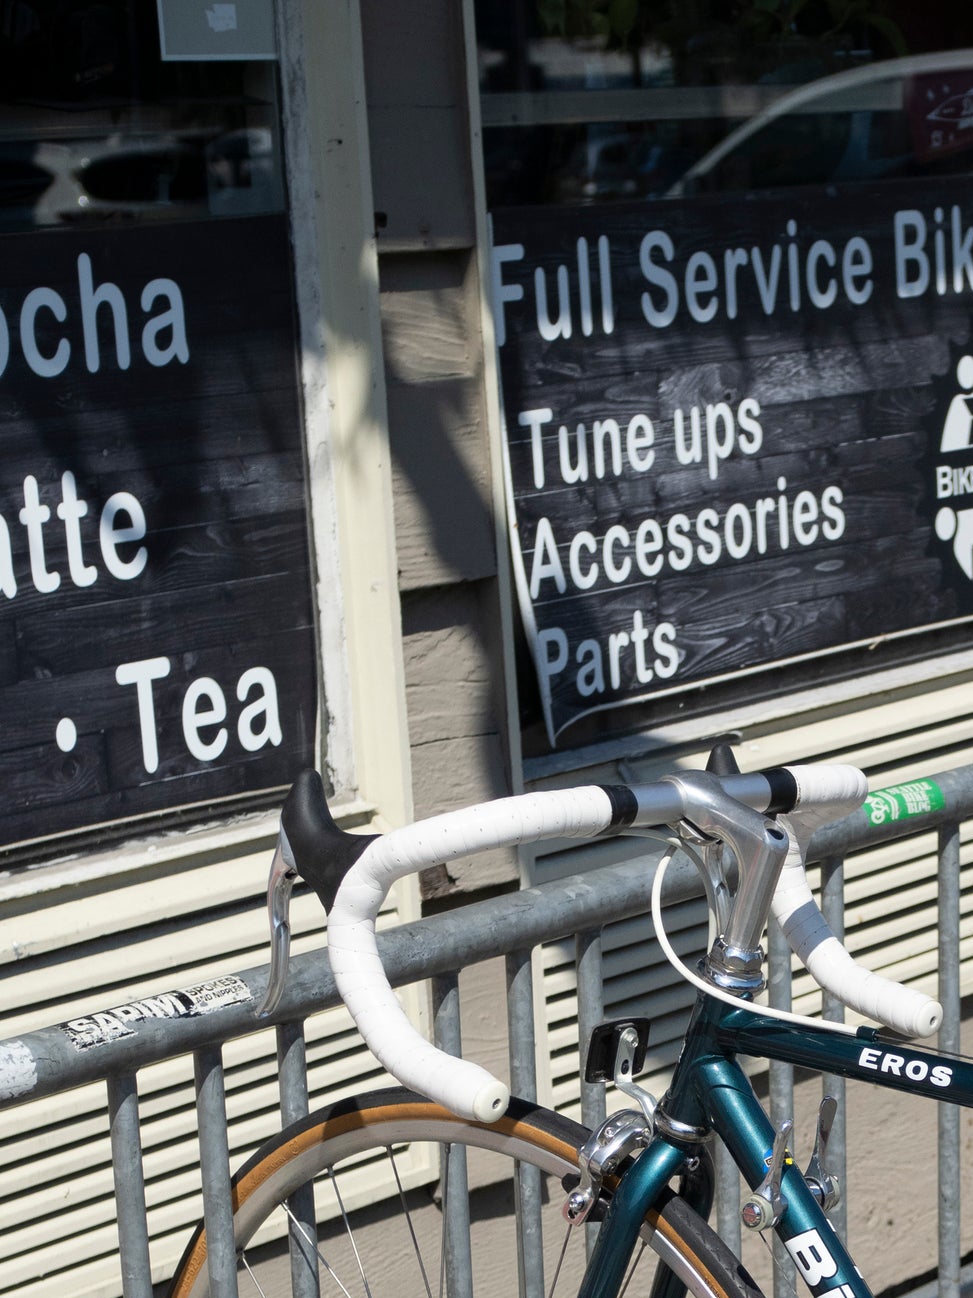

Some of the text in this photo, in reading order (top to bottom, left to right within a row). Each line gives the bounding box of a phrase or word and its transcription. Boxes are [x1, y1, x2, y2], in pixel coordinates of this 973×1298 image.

[0, 253, 190, 378] cha
[491, 235, 614, 347] Full
[639, 221, 873, 329] Service
[520, 398, 763, 489] Tune ups
[529, 477, 846, 600] Accessories
[537, 609, 680, 697] Parts
[115, 656, 283, 774] Tea
[858, 1047, 954, 1087] EROS
